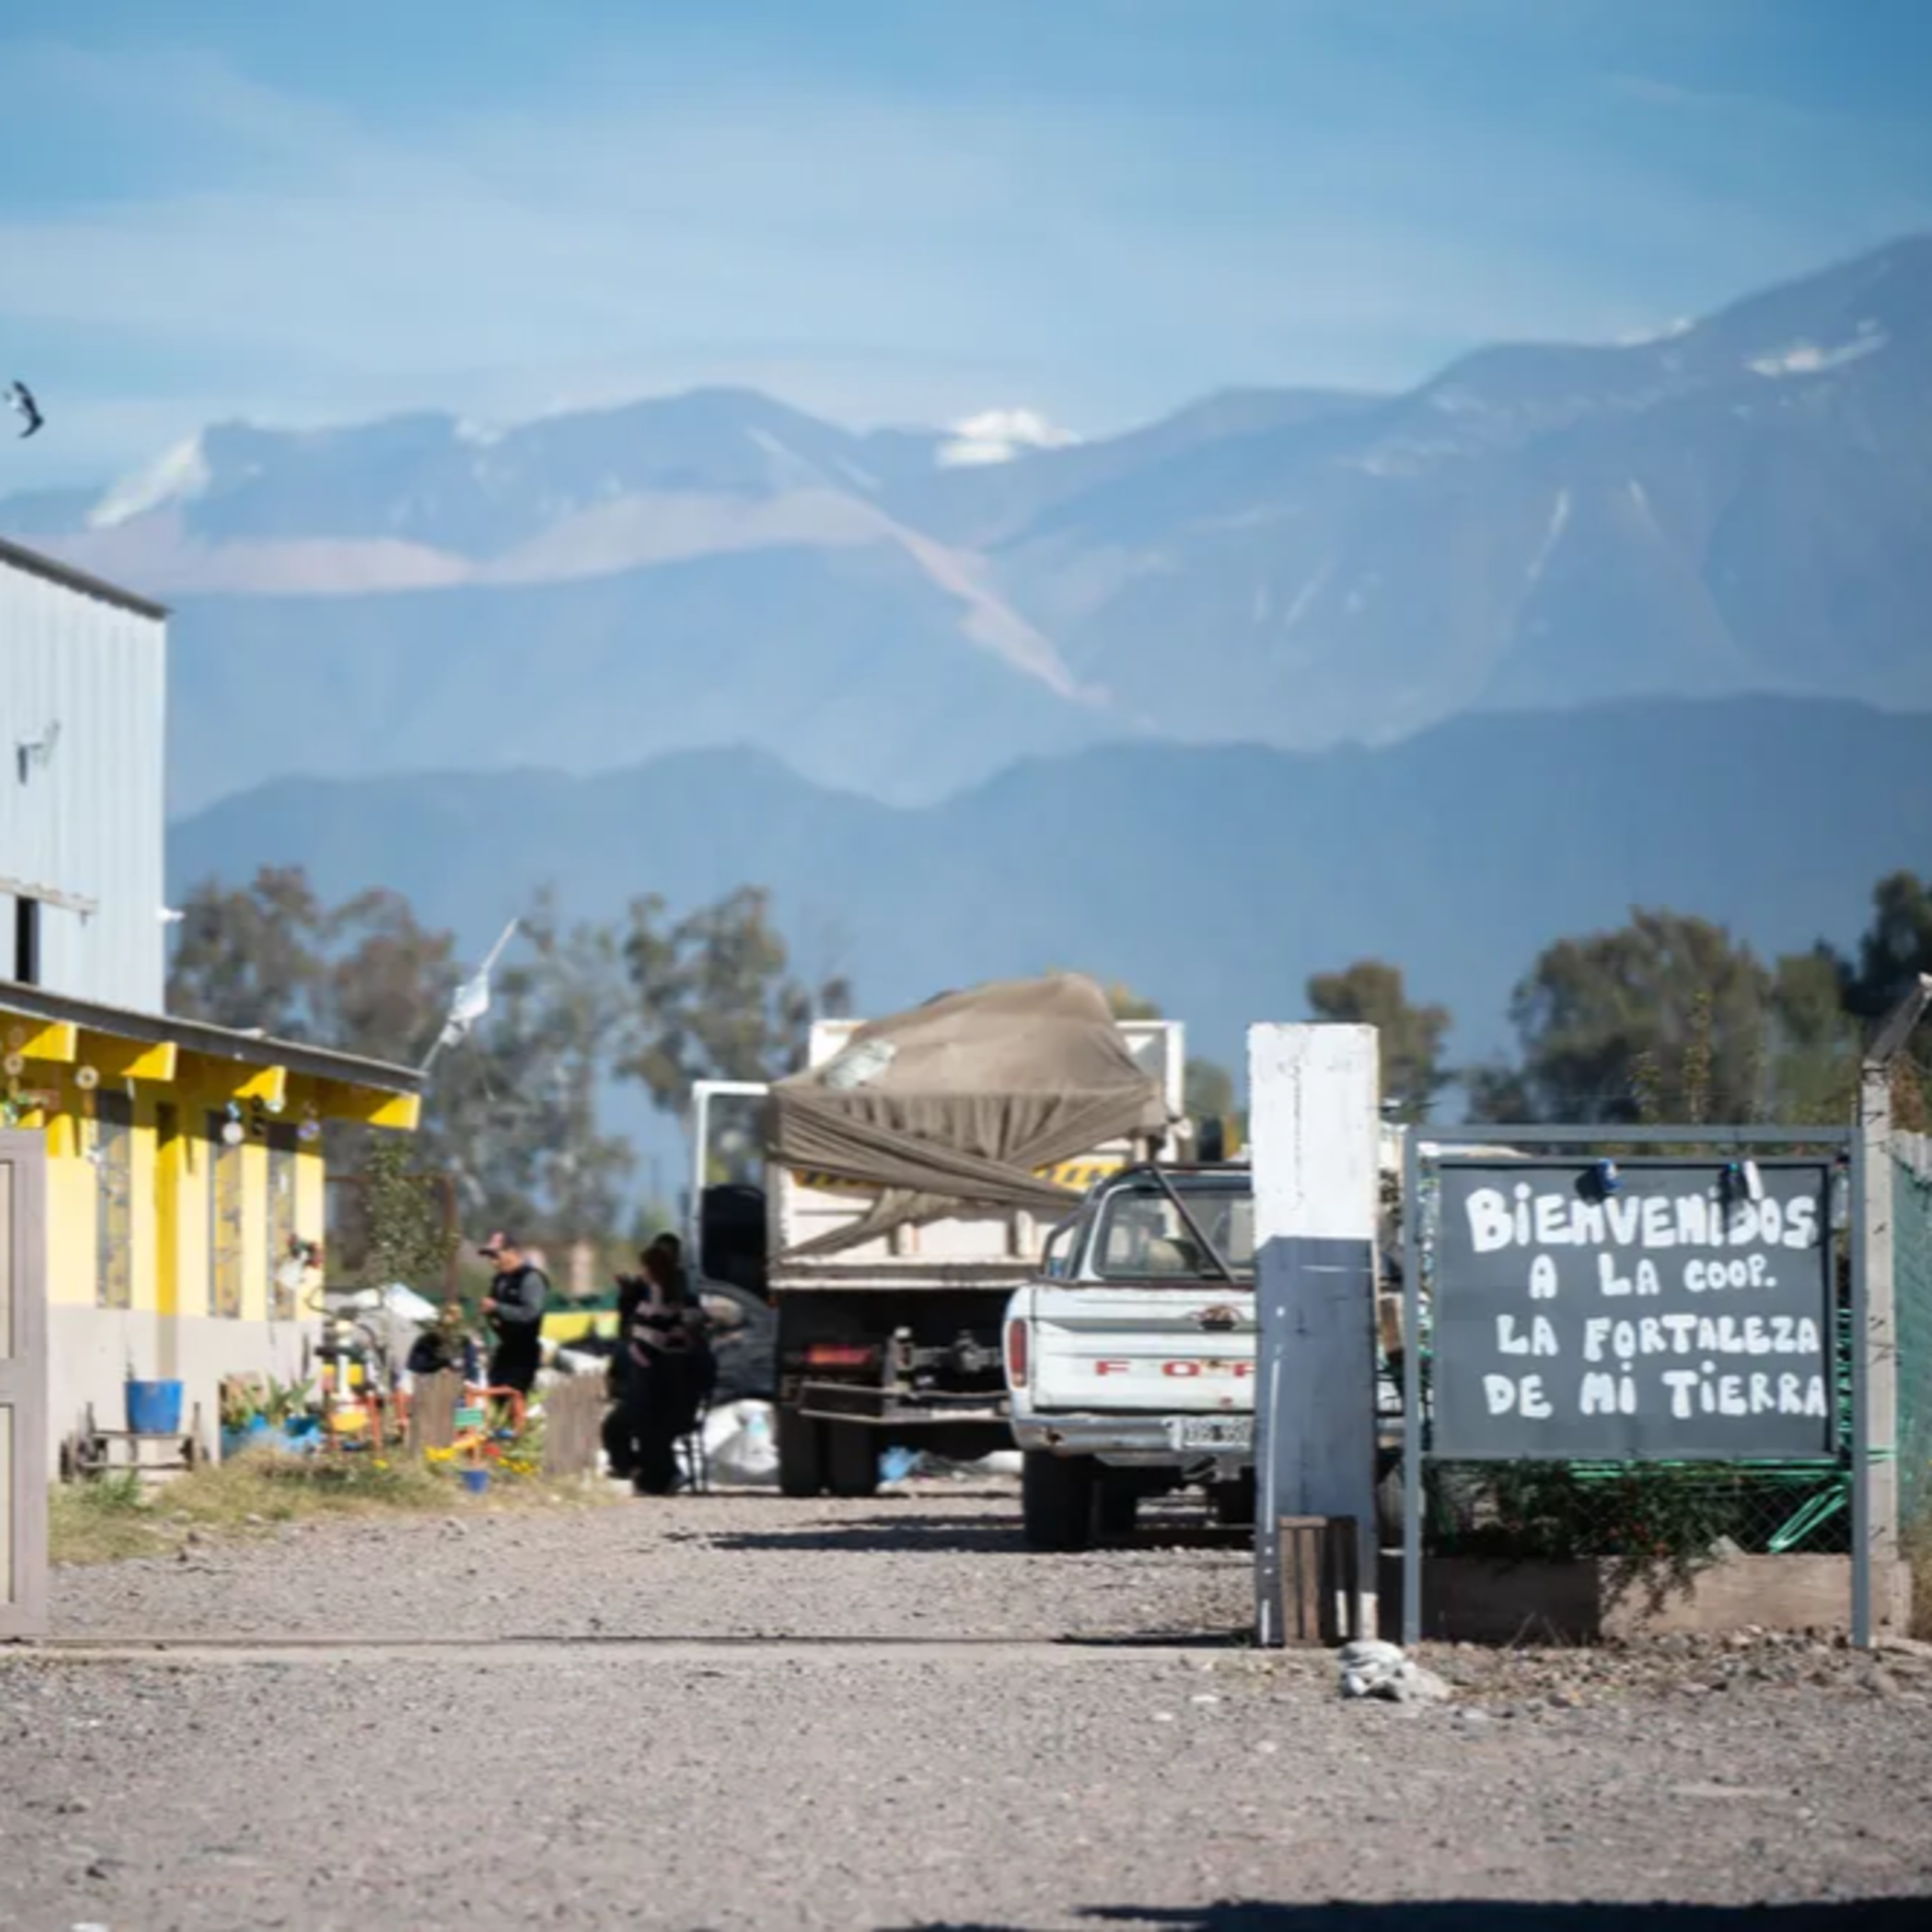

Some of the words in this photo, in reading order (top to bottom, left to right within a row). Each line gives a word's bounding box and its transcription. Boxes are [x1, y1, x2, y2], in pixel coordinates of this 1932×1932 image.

[1529, 1253, 1558, 1299] A
[1597, 1252, 1661, 1296] LA
[1683, 1253, 1777, 1293] COOP.
[1496, 1314, 1559, 1356] LA
[1584, 1313, 1821, 1361] FORTALEZA
[1483, 1374, 1553, 1418] DE
